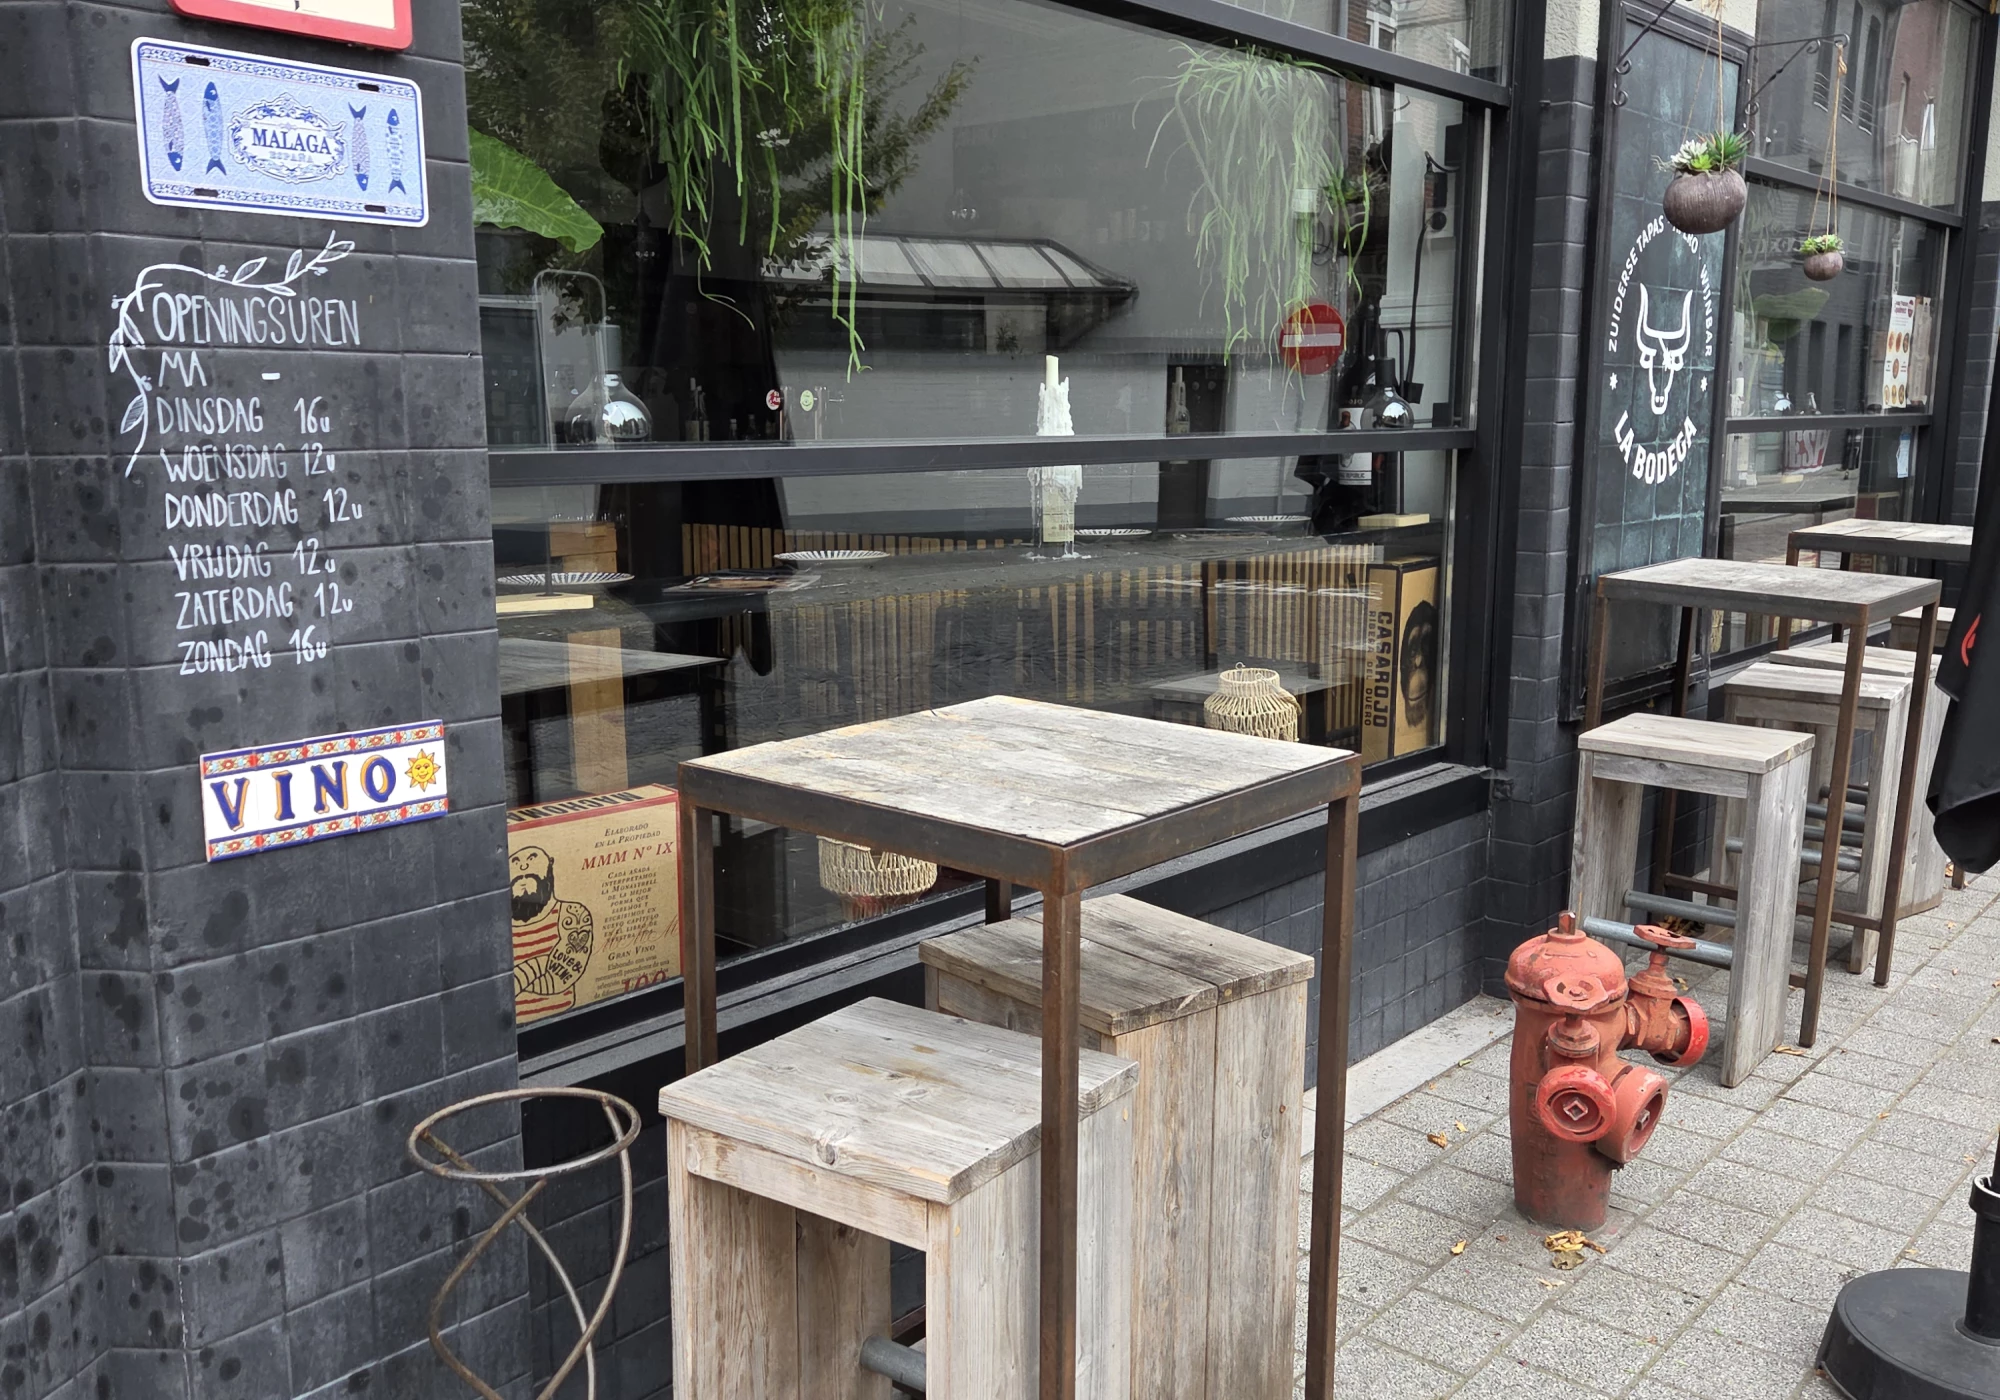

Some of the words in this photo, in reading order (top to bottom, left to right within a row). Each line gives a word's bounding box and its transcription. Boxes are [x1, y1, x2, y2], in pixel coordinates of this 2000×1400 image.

[251, 127, 332, 155] MALAGA
[1609, 246, 1639, 352] ZUIDERSE
[1636, 214, 1664, 253] TAPAS
[1700, 264, 1713, 357] WIJNBAR
[152, 292, 360, 345] OPENINGSUREN
[158, 350, 207, 387] MA
[156, 396, 263, 434] DINSDAG
[160, 443, 288, 482] WOENSDAG
[1614, 410, 1634, 463] LA
[1632, 415, 1697, 485] BODEGA
[165, 488, 299, 529] DONDERDAG
[168, 541, 271, 581] VRIJDAG
[174, 582, 294, 630] ZATERDAG
[1365, 610, 1376, 654] RIBERA
[177, 630, 272, 676] ZONDAG
[1365, 661, 1373, 680] DEL
[1373, 611, 1392, 728] CASAROJO
[1364, 687, 1373, 726] DUERO
[210, 754, 397, 832] VINO
[581, 850, 628, 870] MMM
[656, 841, 674, 856] IX
